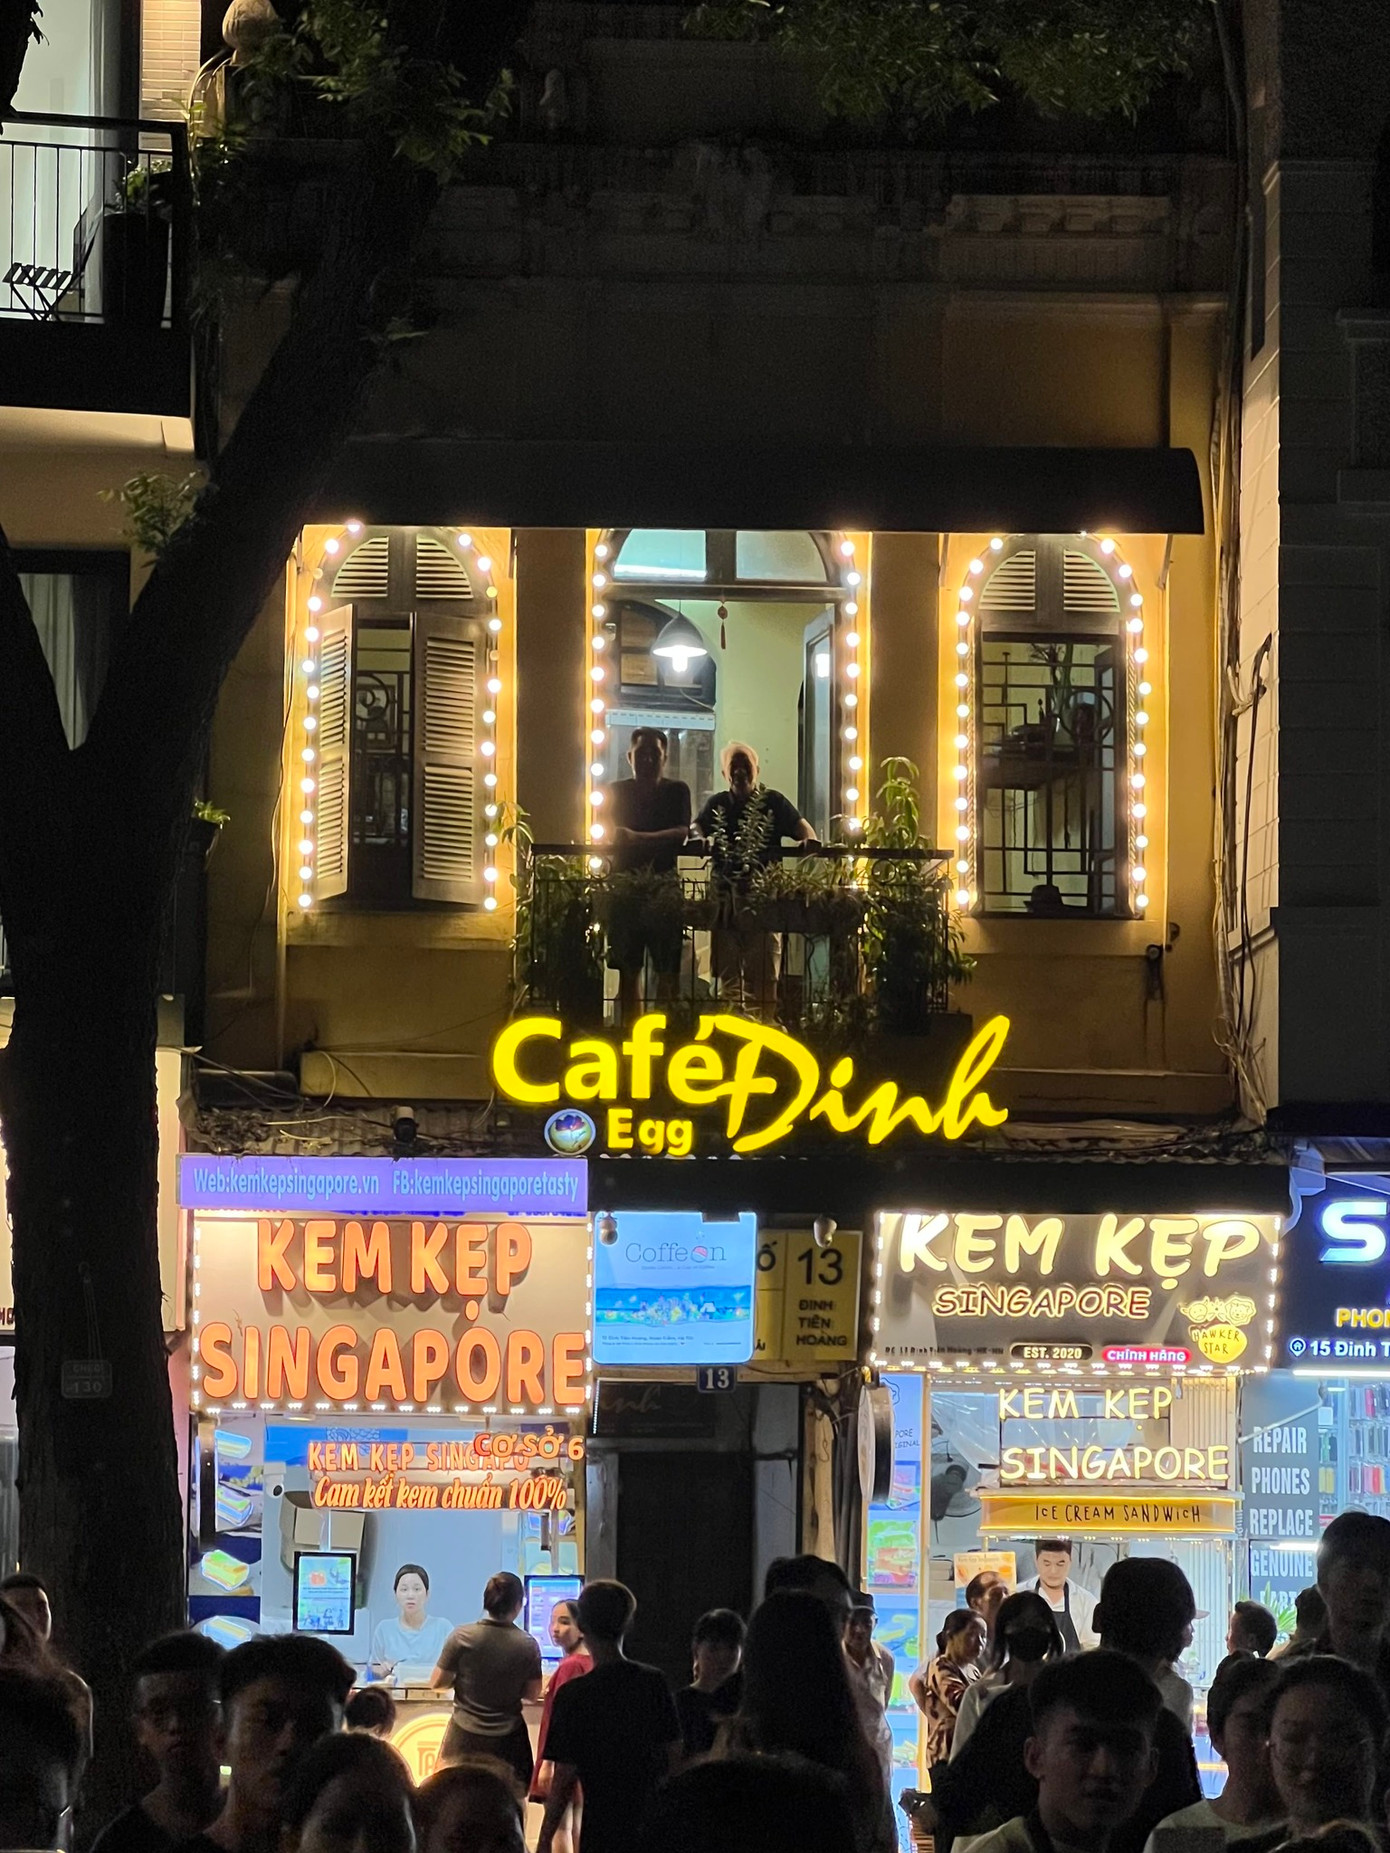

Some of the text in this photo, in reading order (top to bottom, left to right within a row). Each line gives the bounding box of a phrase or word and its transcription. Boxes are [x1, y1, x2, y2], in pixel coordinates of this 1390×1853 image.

[492, 1014, 724, 1103] Café
[607, 1108, 693, 1156] Egg
[194, 1168, 379, 1203] Web:kemkepsingapore.vn
[257, 1219, 393, 1294] KEM
[798, 1248, 843, 1285] 13
[899, 1214, 1260, 1290] KEM KẸP
[932, 1282, 1152, 1320] SINGAPORE
[798, 1316, 831, 1329] TIÊN
[1192, 1329, 1240, 1342] HAWKER
[200, 1322, 586, 1405] SINGAPORE
[1023, 1347, 1082, 1360] EST. 2020
[1203, 1342, 1229, 1355] STAR
[1310, 1342, 1331, 1357] 15
[1334, 1341, 1377, 1357] Đinh
[705, 1369, 730, 1390] 13
[999, 1387, 1080, 1420] KEM
[473, 1425, 585, 1460] CƠ SỞ 6
[1253, 1427, 1307, 1454] REPAIR
[308, 1442, 359, 1471] KEM
[1000, 1445, 1230, 1481] SINGAPORE
[314, 1472, 567, 1510] Cam kết kem chuẩn 100%
[1251, 1467, 1310, 1495] PHONES
[1065, 1504, 1115, 1522] CREAM
[1250, 1508, 1314, 1537] REPLACE
[1250, 1550, 1313, 1577] GENUINE
